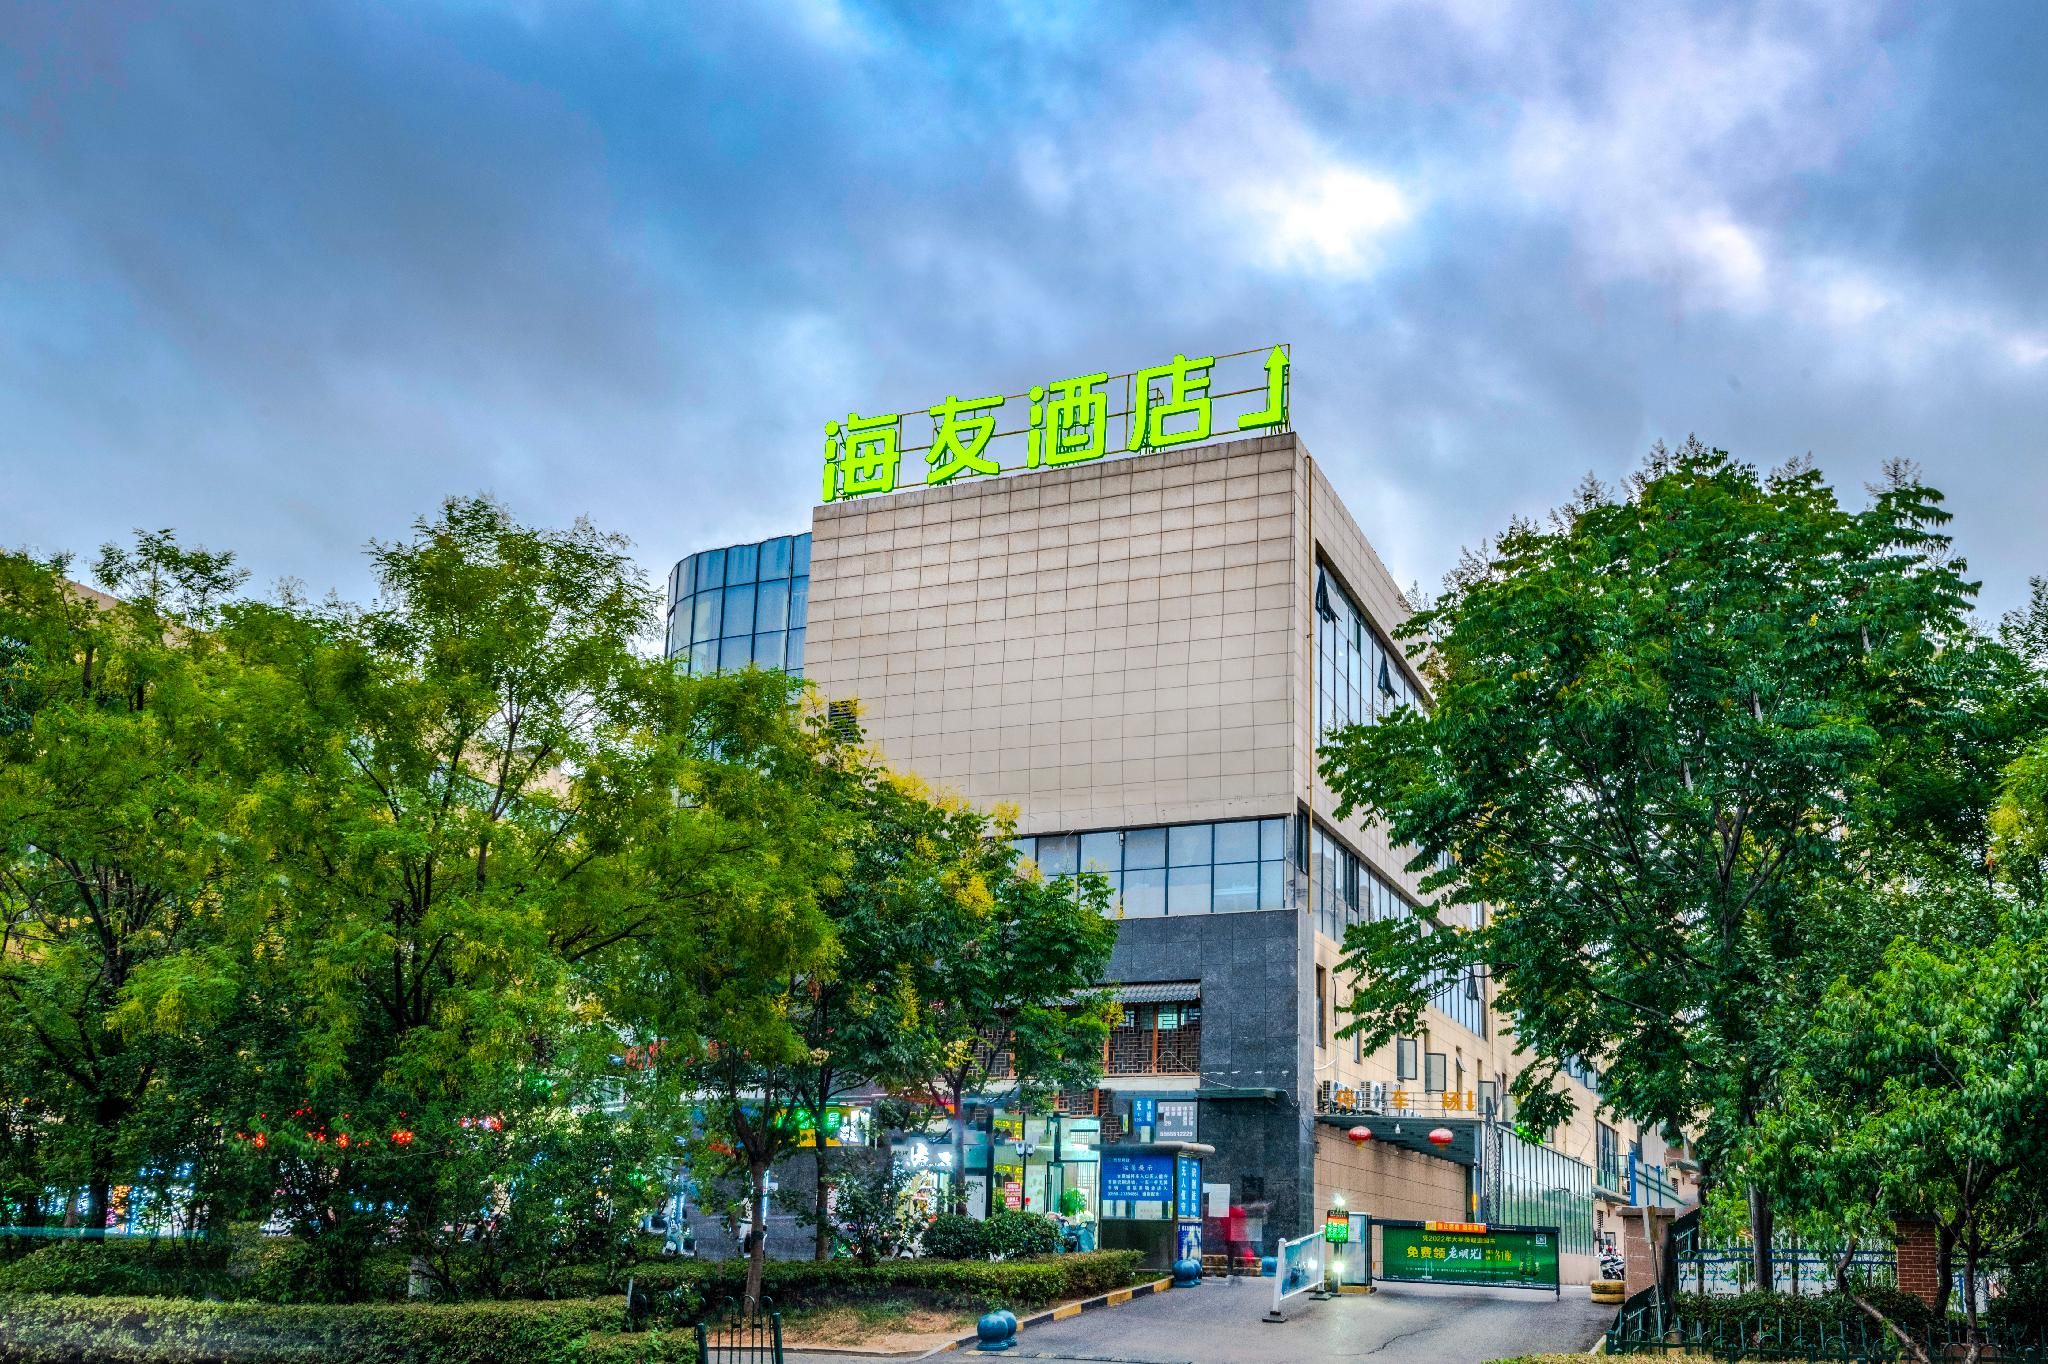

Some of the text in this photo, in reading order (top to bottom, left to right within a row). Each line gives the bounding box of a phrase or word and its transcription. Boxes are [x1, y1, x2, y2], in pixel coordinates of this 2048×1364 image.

[822, 353, 1216, 503] 海友酒店
[1336, 1088, 1462, 1112] 停车场
[1406, 1245, 1446, 1259] 免费领
